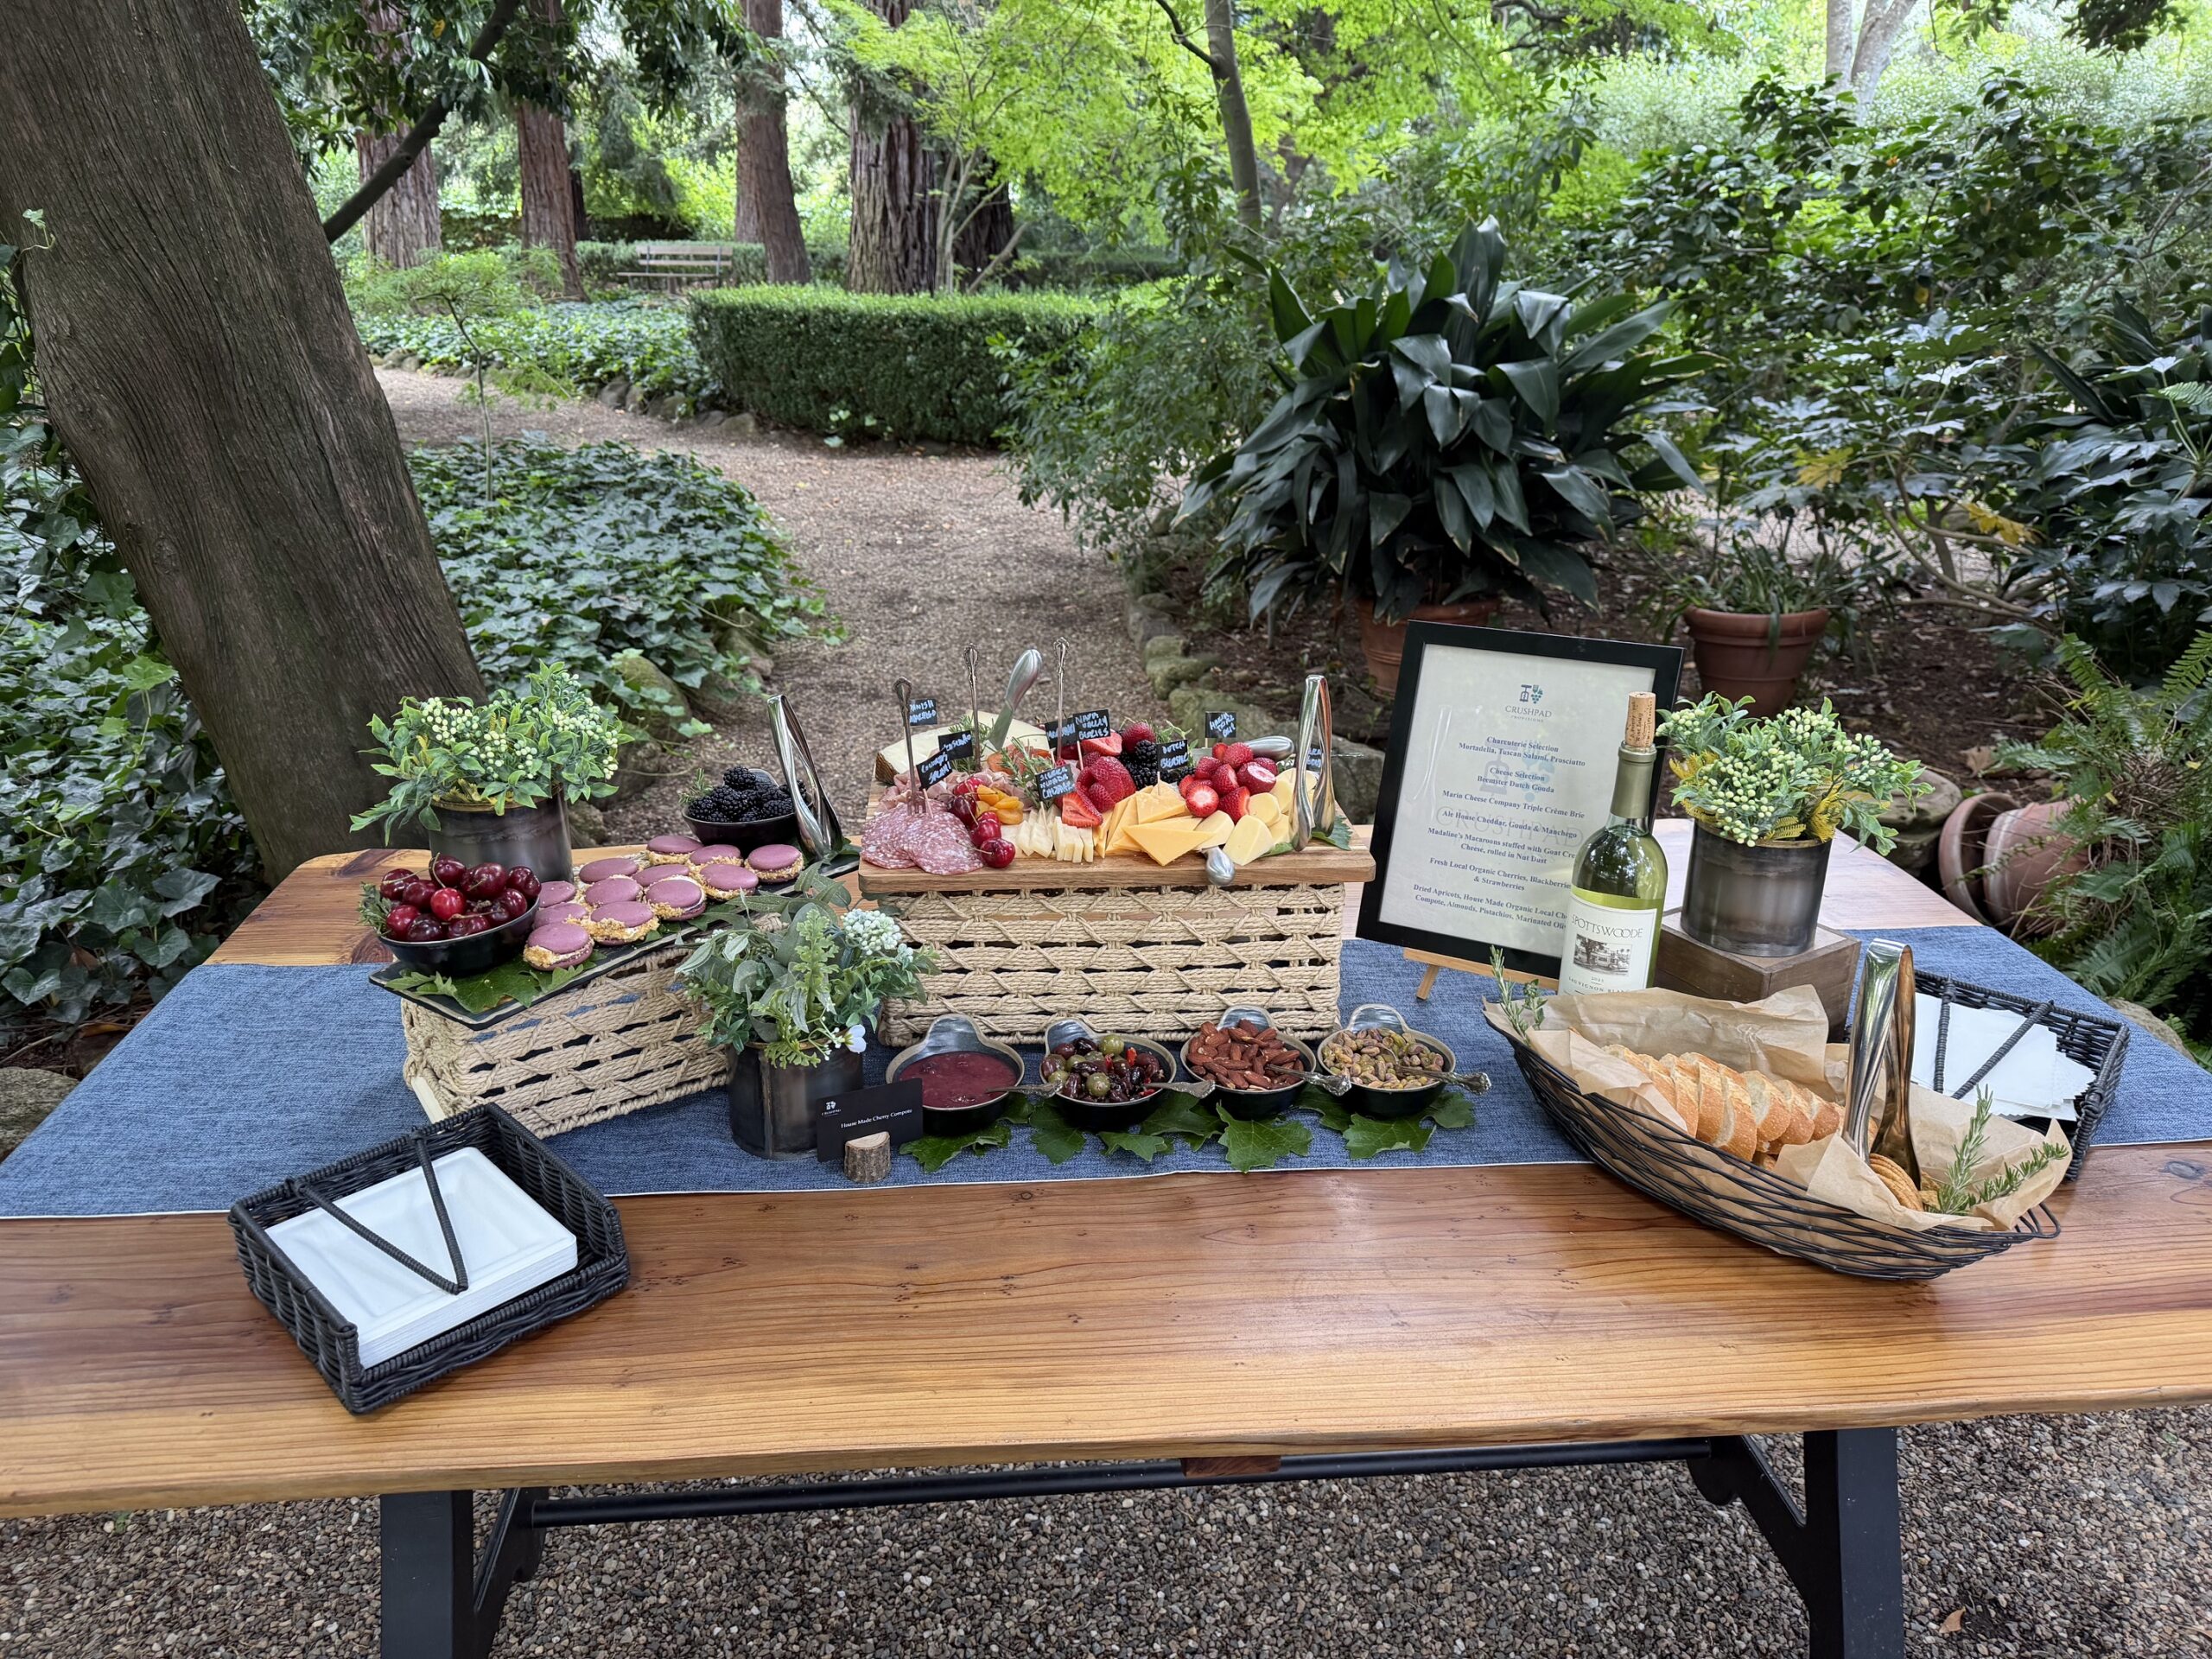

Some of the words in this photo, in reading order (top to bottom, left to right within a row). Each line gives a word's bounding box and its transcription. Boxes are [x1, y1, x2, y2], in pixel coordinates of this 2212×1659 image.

[1505, 705, 1552, 718] CRUSHPAD
[1459, 742, 1497, 755] Mortadella,
[1498, 748, 1522, 758] Tuscan
[1522, 752, 1549, 762] Salami,
[1550, 756, 1586, 766] Prosciutto
[1486, 736, 1527, 748] Charcuterie
[1529, 742, 1559, 753] Selection
[1490, 766, 1513, 777] Cheese
[1515, 771, 1545, 782] Selection
[1510, 780, 1530, 790] Dutch
[1532, 784, 1554, 793] Gouda
[1442, 790, 1463, 799] Marin
[1465, 793, 1487, 804] Cheese
[1489, 797, 1521, 810] Company
[1522, 803, 1543, 813] Triple
[1544, 806, 1568, 816] Crème
[1569, 810, 1585, 819] Brie
[1455, 812, 1476, 822] House
[1477, 816, 1507, 827] Cheddar,
[1509, 821, 1531, 830] Gouda
[1541, 826, 1578, 839] Manchego
[1427, 827, 1463, 839] Madaline's
[1465, 834, 1501, 846] Macaroons
[1502, 839, 1526, 851] stuffed
[1527, 844, 1542, 854] with
[1543, 848, 1561, 856] Goat
[1562, 850, 1576, 859] Cre
[1460, 843, 1485, 854] Cheese,
[1487, 848, 1506, 857] rolled
[1516, 853, 1529, 861] Nut
[1530, 855, 1548, 864] Dust
[1430, 857, 1448, 867] Fresh
[1449, 861, 1468, 870] Local
[1469, 865, 1496, 875] Organic
[1497, 869, 1528, 881] Cherries,
[1482, 877, 1525, 891] Strawberries
[1413, 884, 1432, 893] Dried
[1433, 887, 1462, 899] Apricots,
[1463, 893, 1484, 904] House
[1485, 897, 1505, 907] Made
[1506, 901, 1534, 914] Organic
[1535, 907, 1554, 917] Local
[1415, 894, 1446, 907] Compote,
[1446, 900, 1478, 913] Almonds,
[1478, 906, 1515, 920] Pistachios,
[1516, 913, 1553, 926] Marinated
[1572, 913, 1643, 938] SPOTTSWOODE
[873, 1113, 889, 1122] Cherry
[890, 1109, 912, 1118] Compote
